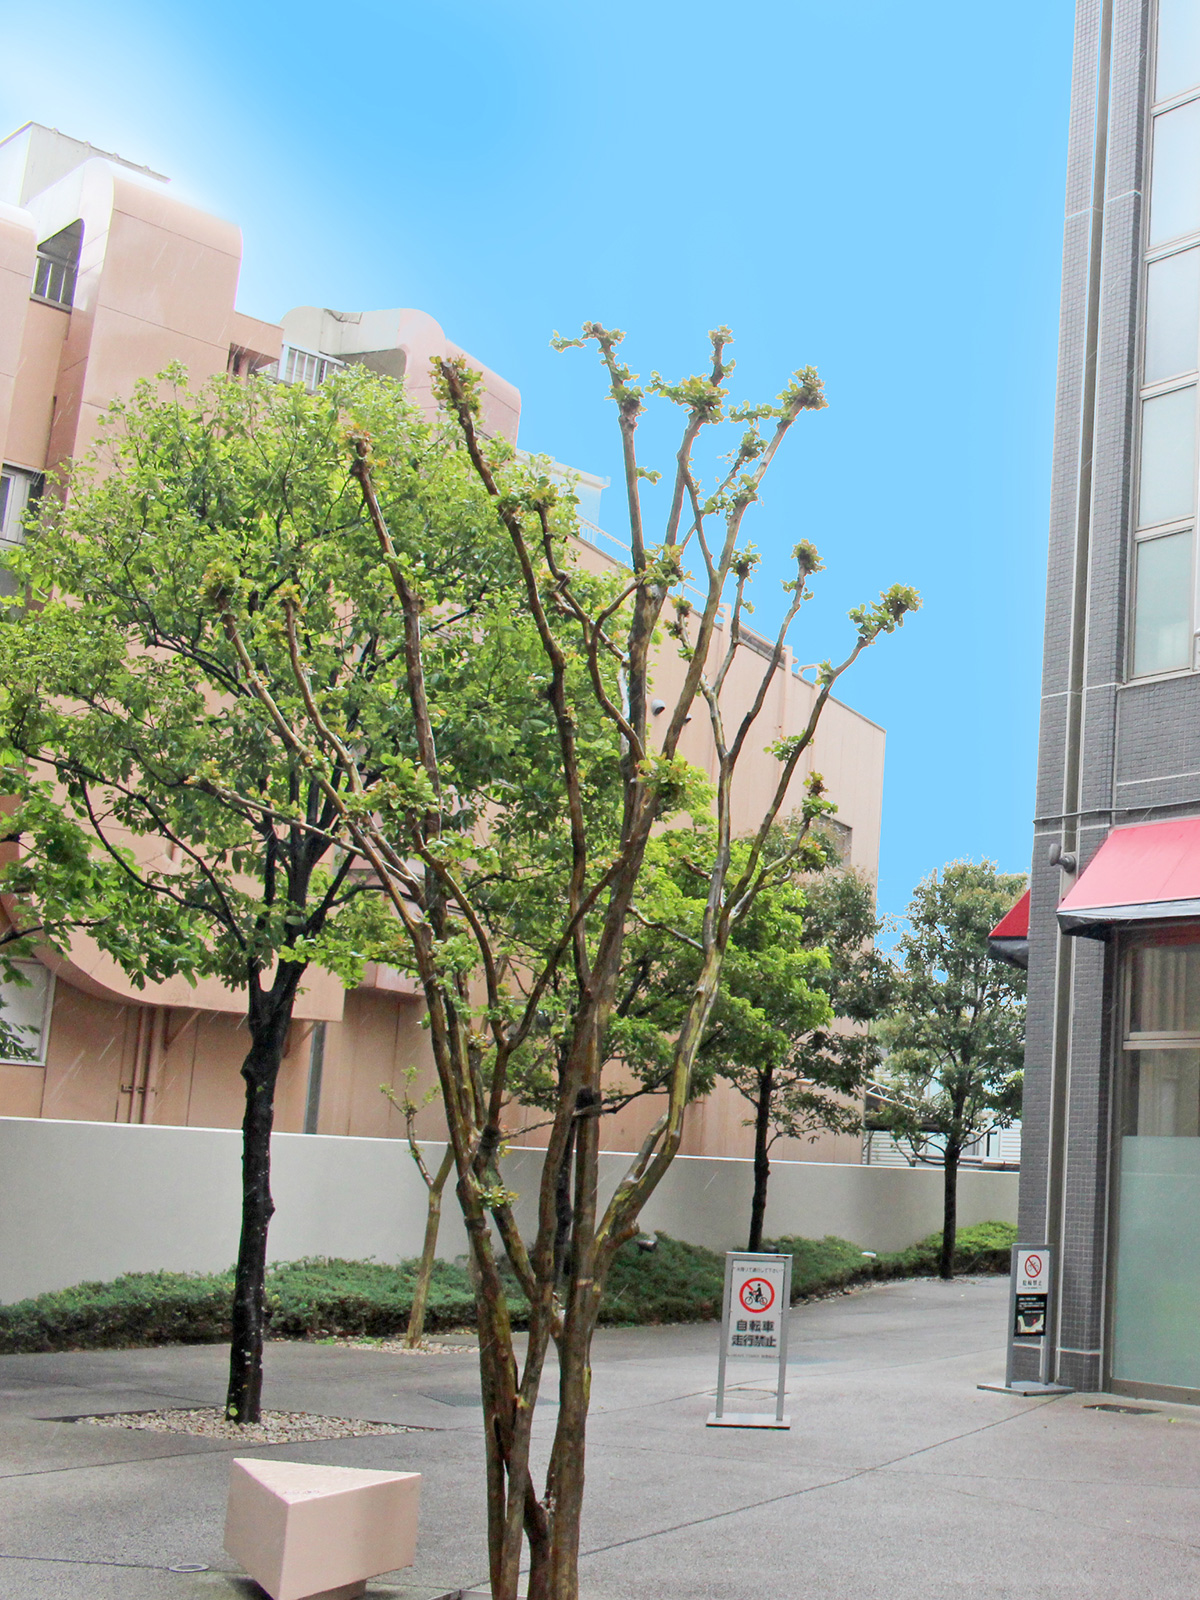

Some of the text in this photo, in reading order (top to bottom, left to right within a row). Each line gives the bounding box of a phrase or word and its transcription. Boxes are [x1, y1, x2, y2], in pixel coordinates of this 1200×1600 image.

[736, 1320, 775, 1332] 自転車
[731, 1334, 777, 1348] 走行禁止
